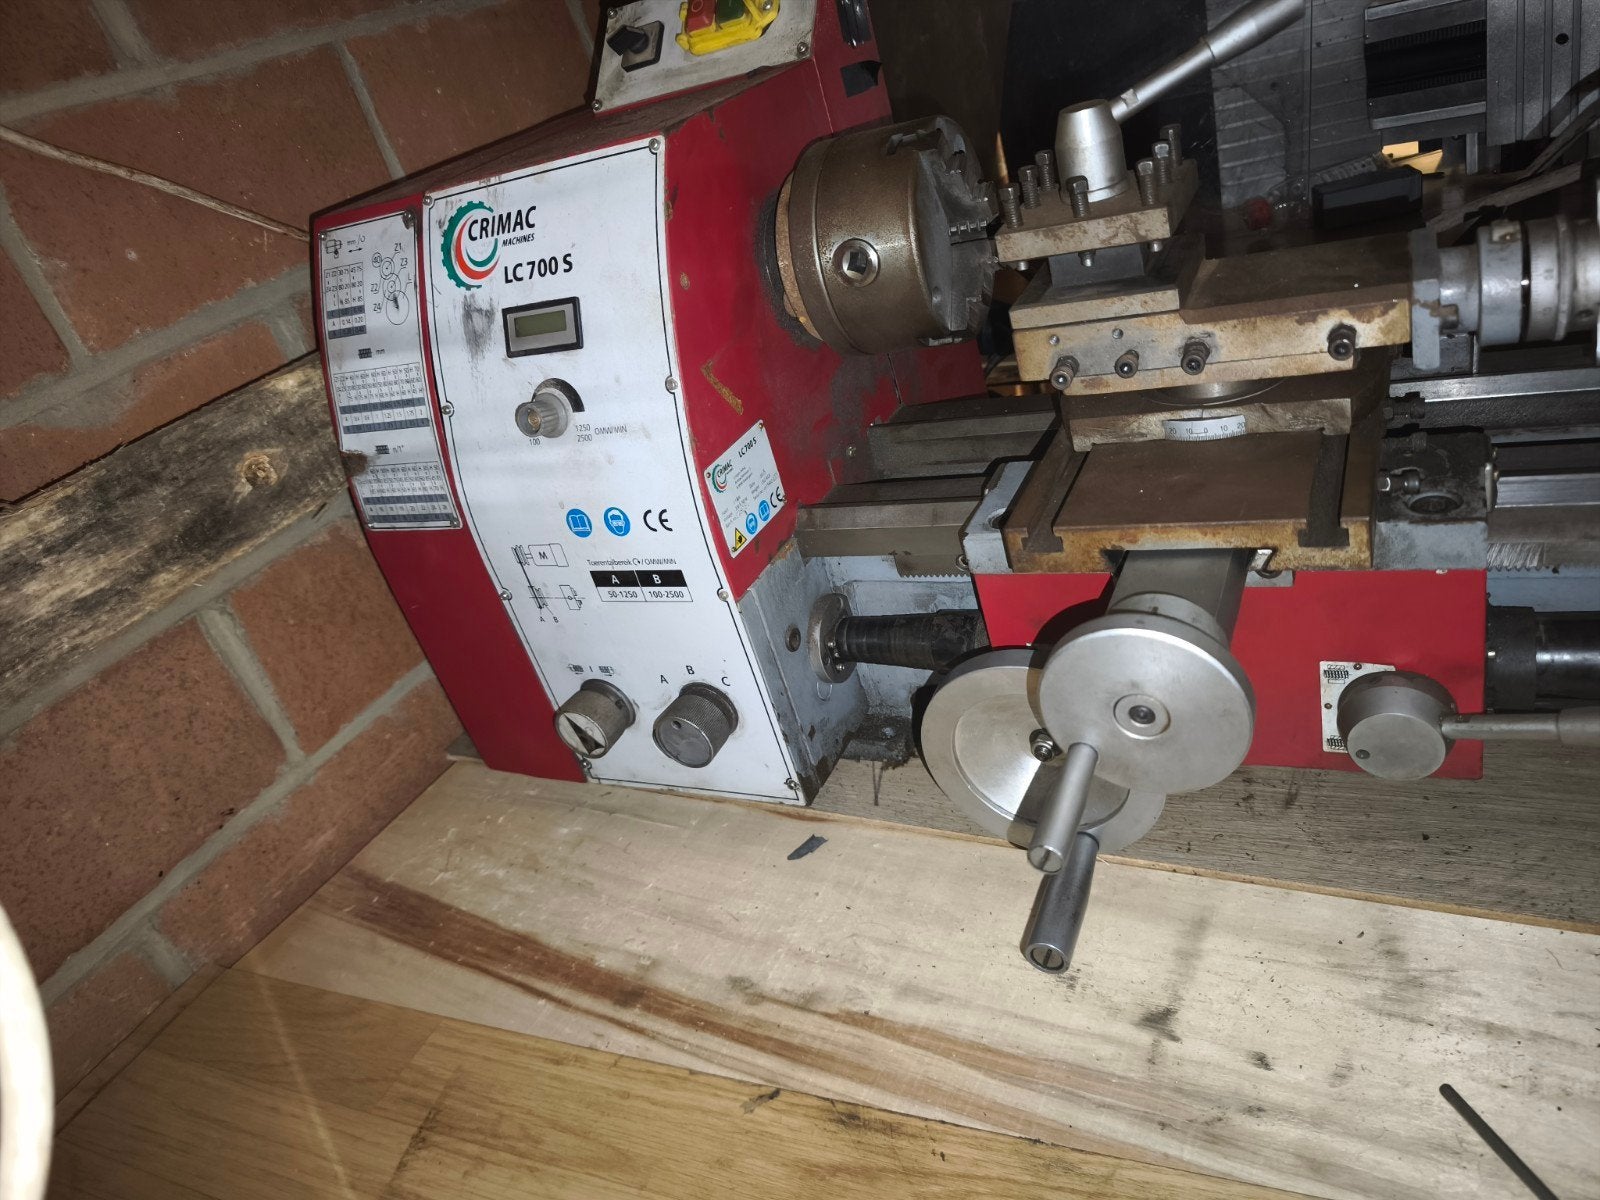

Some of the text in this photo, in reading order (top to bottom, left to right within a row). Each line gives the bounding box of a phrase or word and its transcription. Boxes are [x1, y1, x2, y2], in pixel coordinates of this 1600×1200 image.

[468, 205, 537, 242] CRIMAC
[502, 233, 535, 248] MACHINES
[504, 253, 573, 284] LC 700 S
[575, 423, 591, 432] 1250
[529, 438, 541, 446] 100
[577, 434, 592, 443] 2500
[738, 449, 746, 458] LC
[539, 551, 548, 560] M
[611, 574, 661, 584] A B
[607, 590, 685, 599] 50-1250 100-2500
[660, 674, 669, 684] A
[685, 665, 695, 675] B
[721, 676, 731, 687] C
